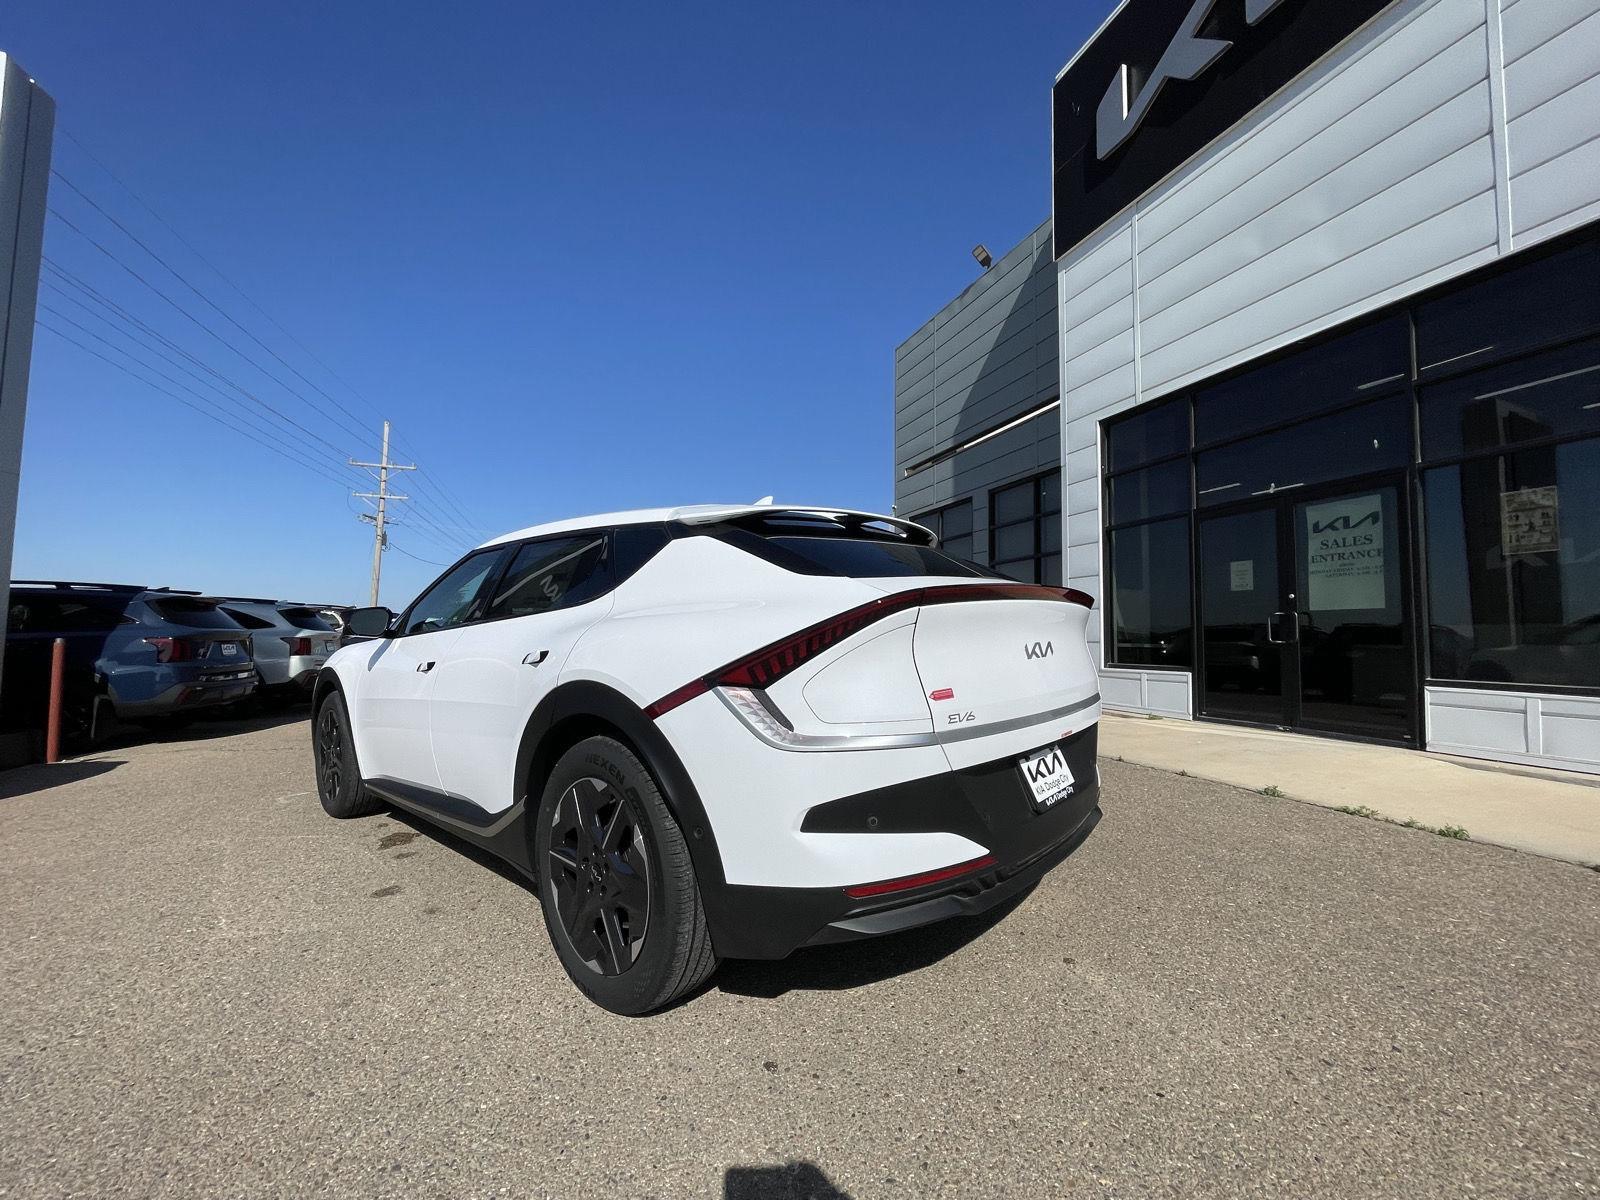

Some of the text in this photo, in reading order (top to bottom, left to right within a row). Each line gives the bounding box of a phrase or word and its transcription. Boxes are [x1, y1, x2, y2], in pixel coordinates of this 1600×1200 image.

[1313, 511, 1380, 533] KIA
[1320, 534, 1373, 550] SALES
[1024, 641, 1053, 659] KIA
[948, 711, 976, 725] EV6
[585, 753, 625, 785] NEXEN
[1027, 752, 1063, 784] KIA
[1035, 775, 1069, 795] KIA Dodge City
